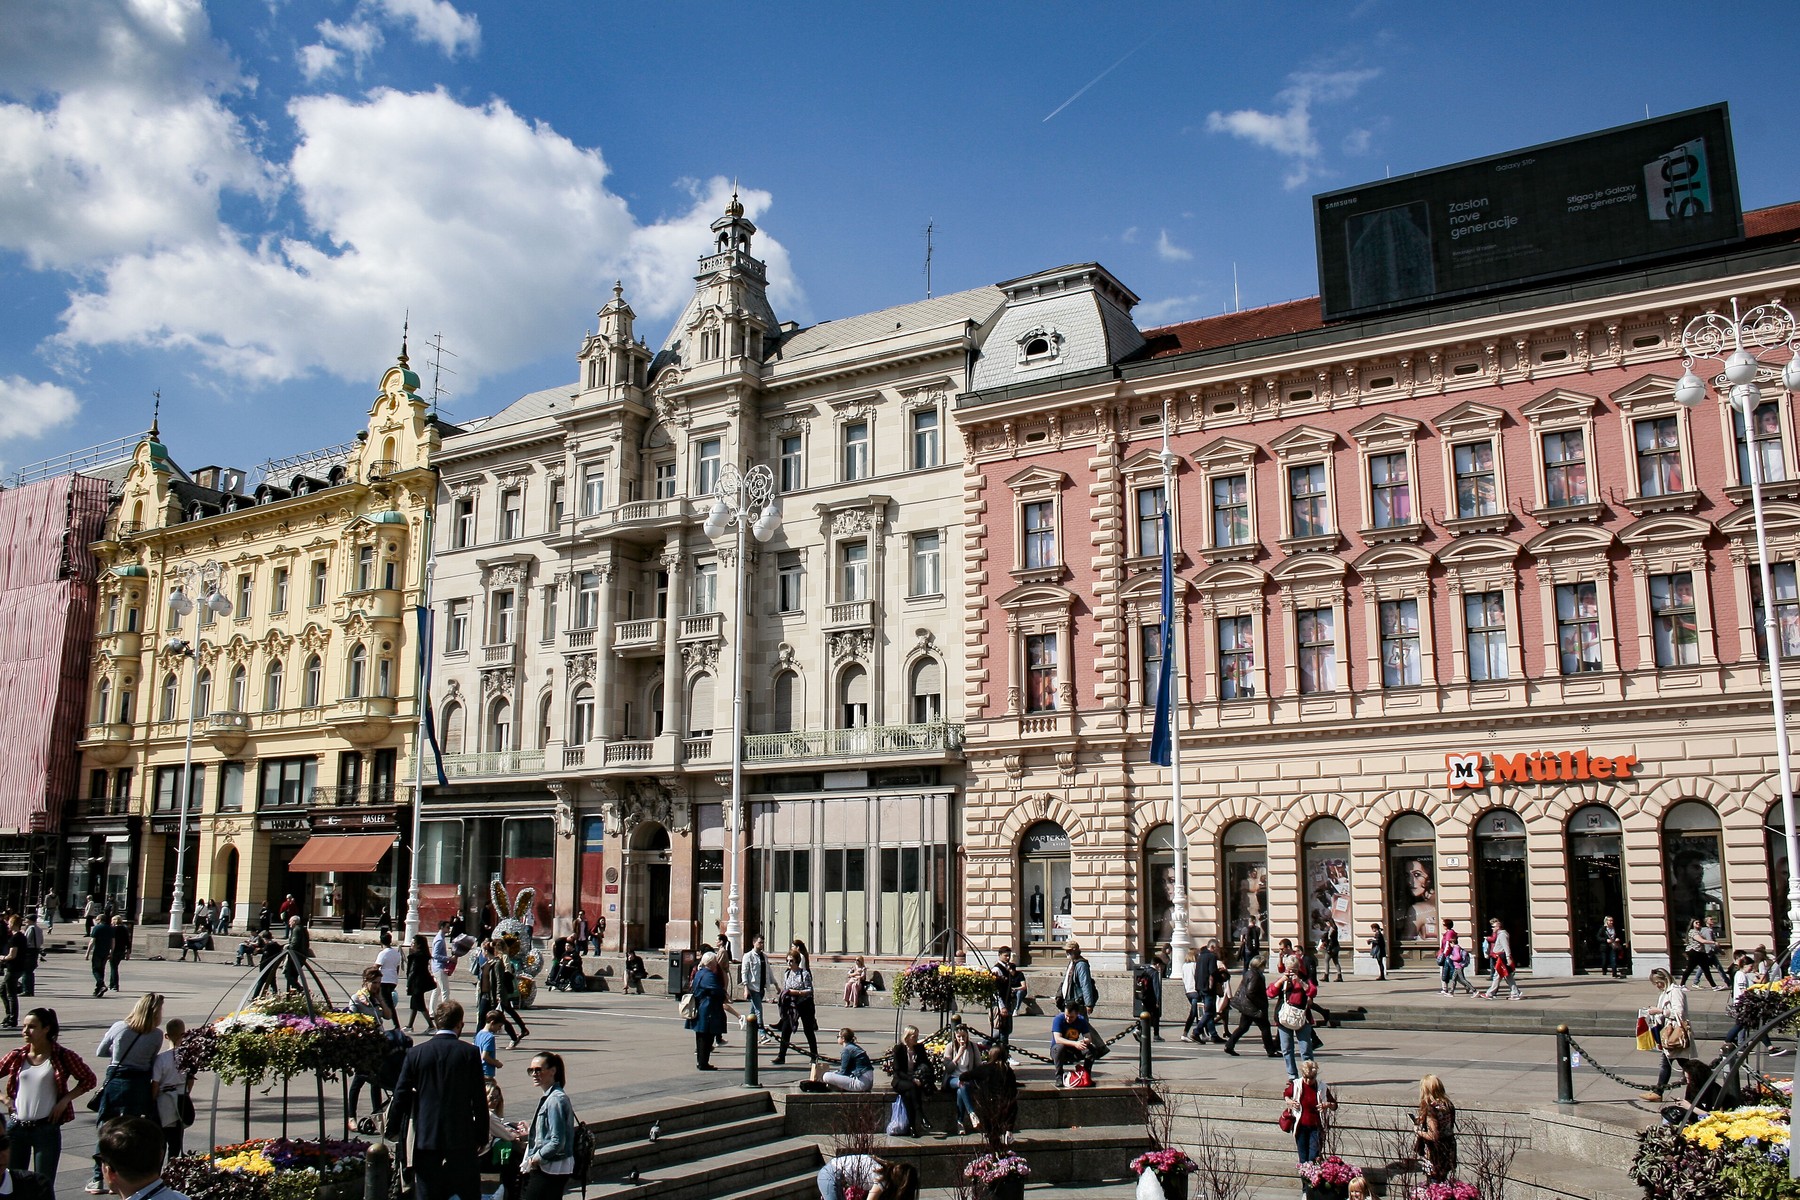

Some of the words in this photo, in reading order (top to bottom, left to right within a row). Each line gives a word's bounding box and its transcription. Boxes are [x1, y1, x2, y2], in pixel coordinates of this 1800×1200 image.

[1495, 161, 1521, 172] Galaxy
[1567, 192, 1594, 205] Stigao
[1595, 189, 1603, 200] je
[1605, 184, 1636, 196] Galaxy
[1325, 198, 1358, 210] SAMSUNG
[1449, 197, 1489, 214] Zaslon
[1568, 202, 1588, 213] nove
[1591, 192, 1638, 210] generacije
[1450, 211, 1480, 225] nove
[1451, 215, 1519, 240] generacije
[1492, 749, 1636, 783] Müller
[362, 814, 386, 824] BASLER
[1030, 834, 1067, 842] VARTEKS
[1669, 836, 1714, 845] BVLGAR
